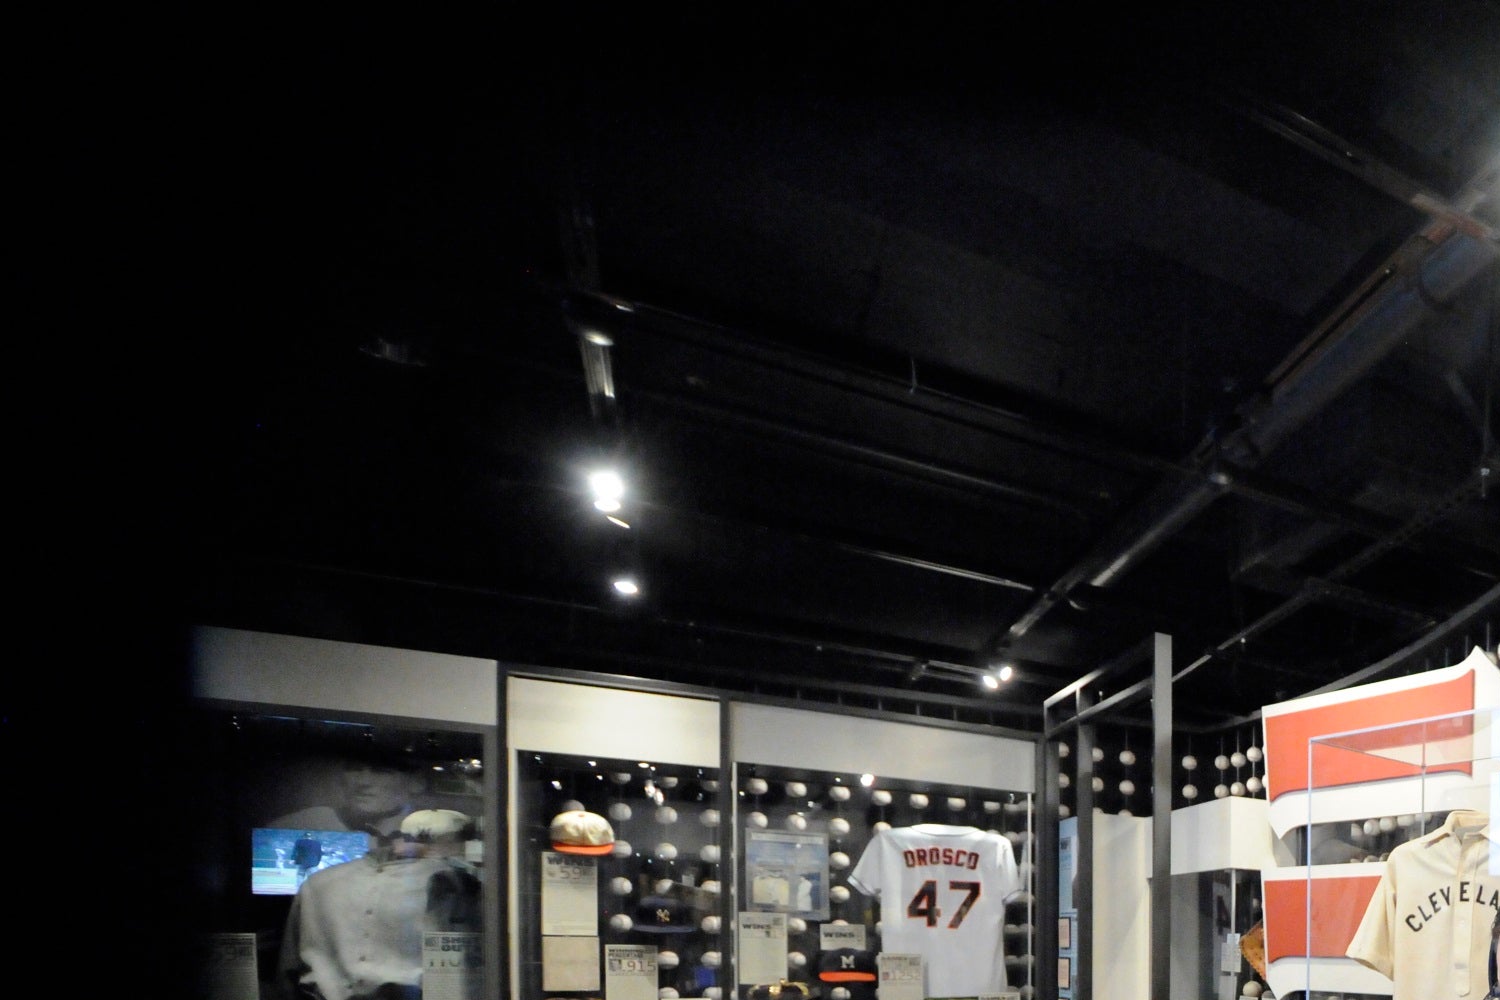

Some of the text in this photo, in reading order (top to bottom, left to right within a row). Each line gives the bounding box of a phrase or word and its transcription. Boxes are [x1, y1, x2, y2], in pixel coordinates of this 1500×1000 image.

[904, 847, 980, 870] OROSCO
[907, 880, 981, 929] 47
[1404, 881, 1499, 932] CLEVELA
[841, 955, 856, 968] M
